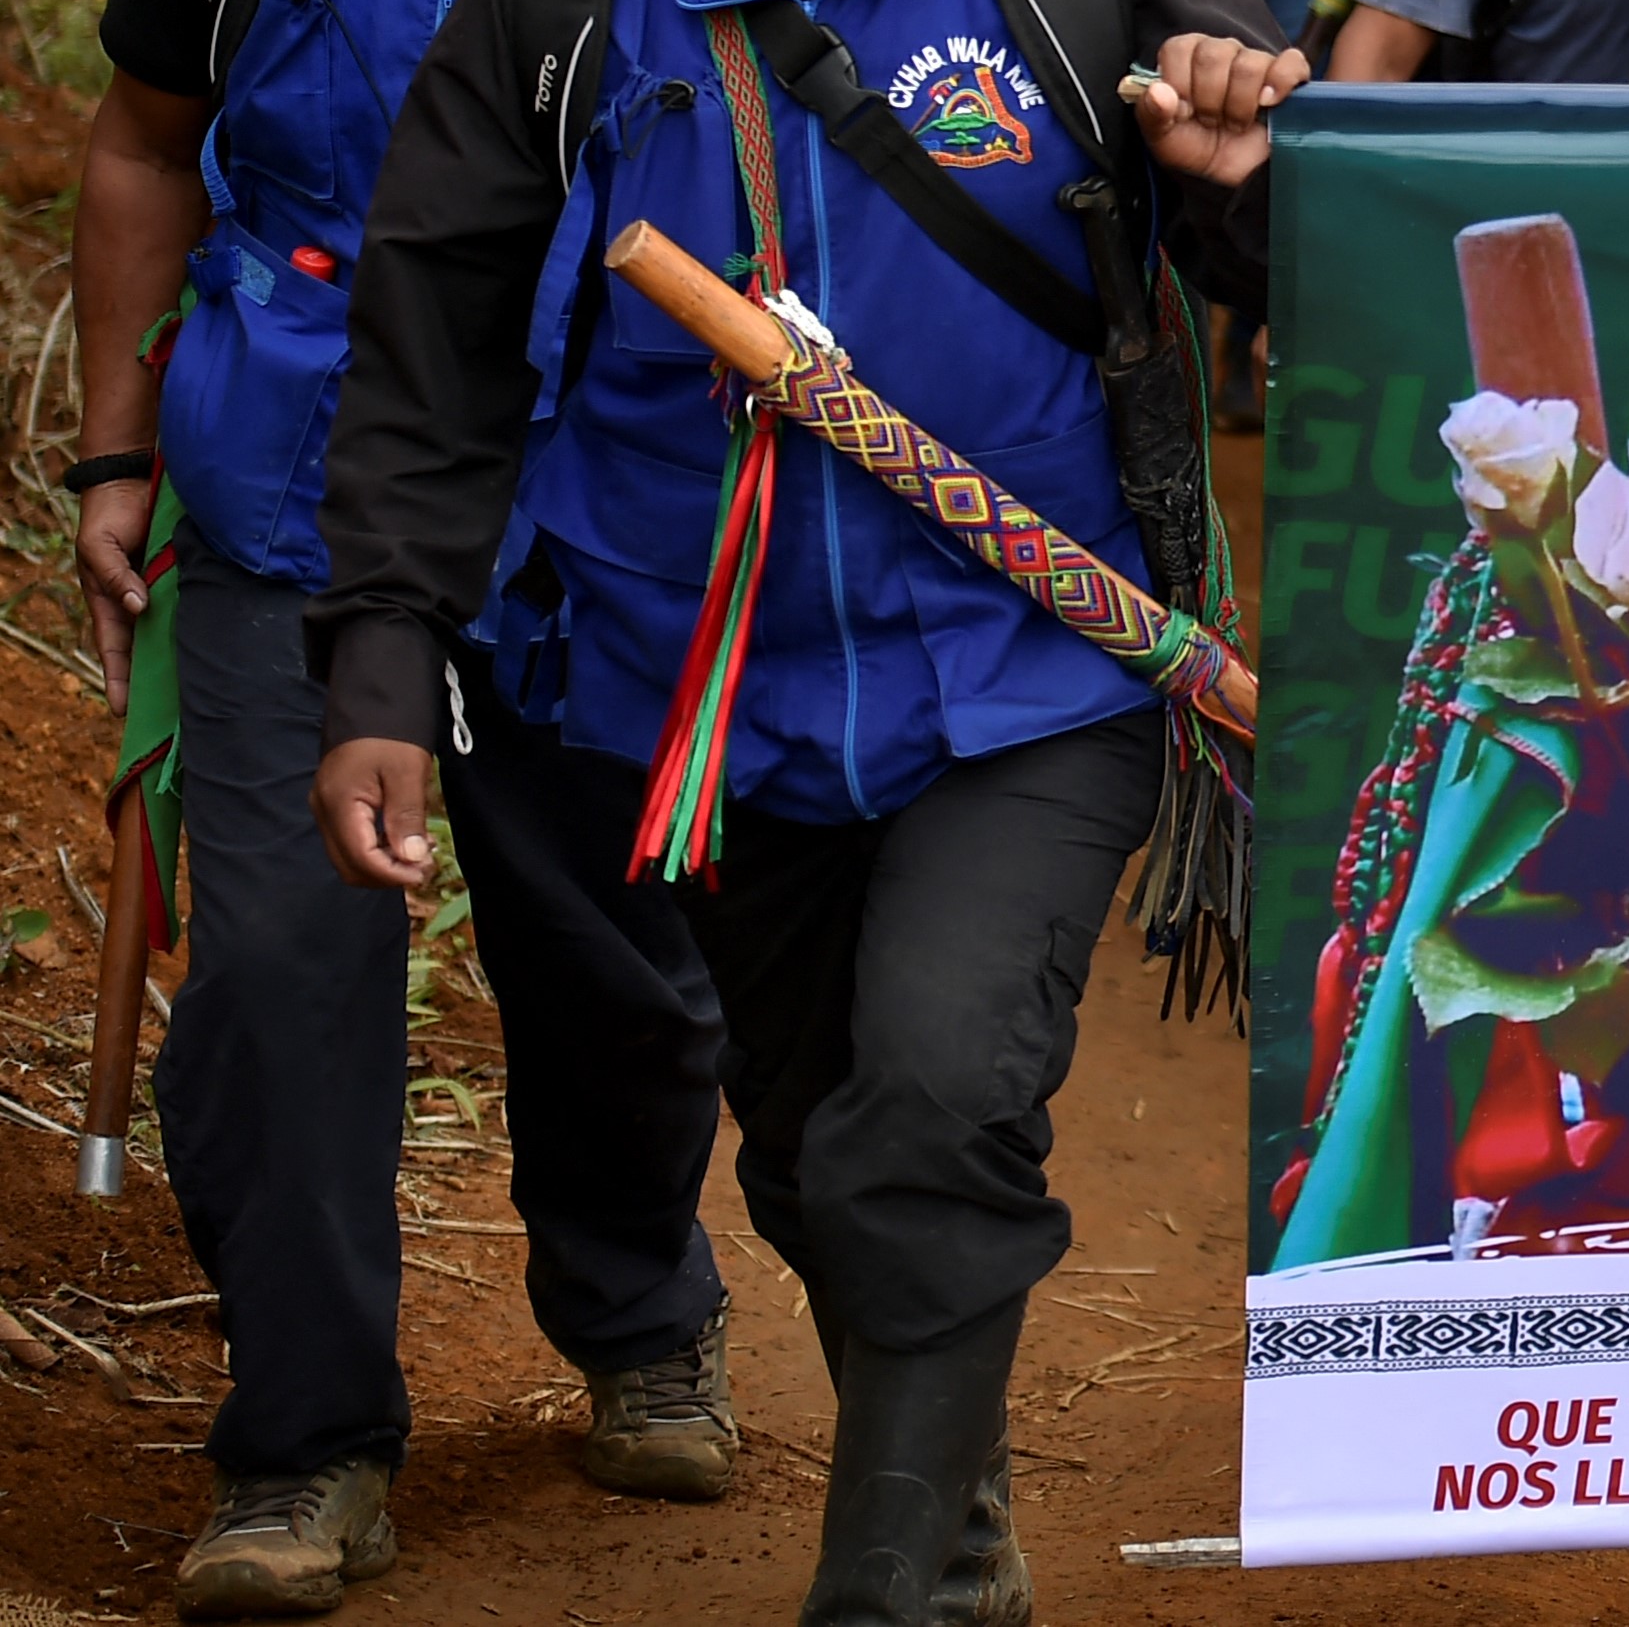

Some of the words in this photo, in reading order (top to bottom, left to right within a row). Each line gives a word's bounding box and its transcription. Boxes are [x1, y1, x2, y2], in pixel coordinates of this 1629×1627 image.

[946, 37, 1007, 73] WALA
[534, 53, 558, 113] TOTTO
[1497, 1397, 1617, 1456] QUE
[1432, 1460, 1556, 1512] NOS
